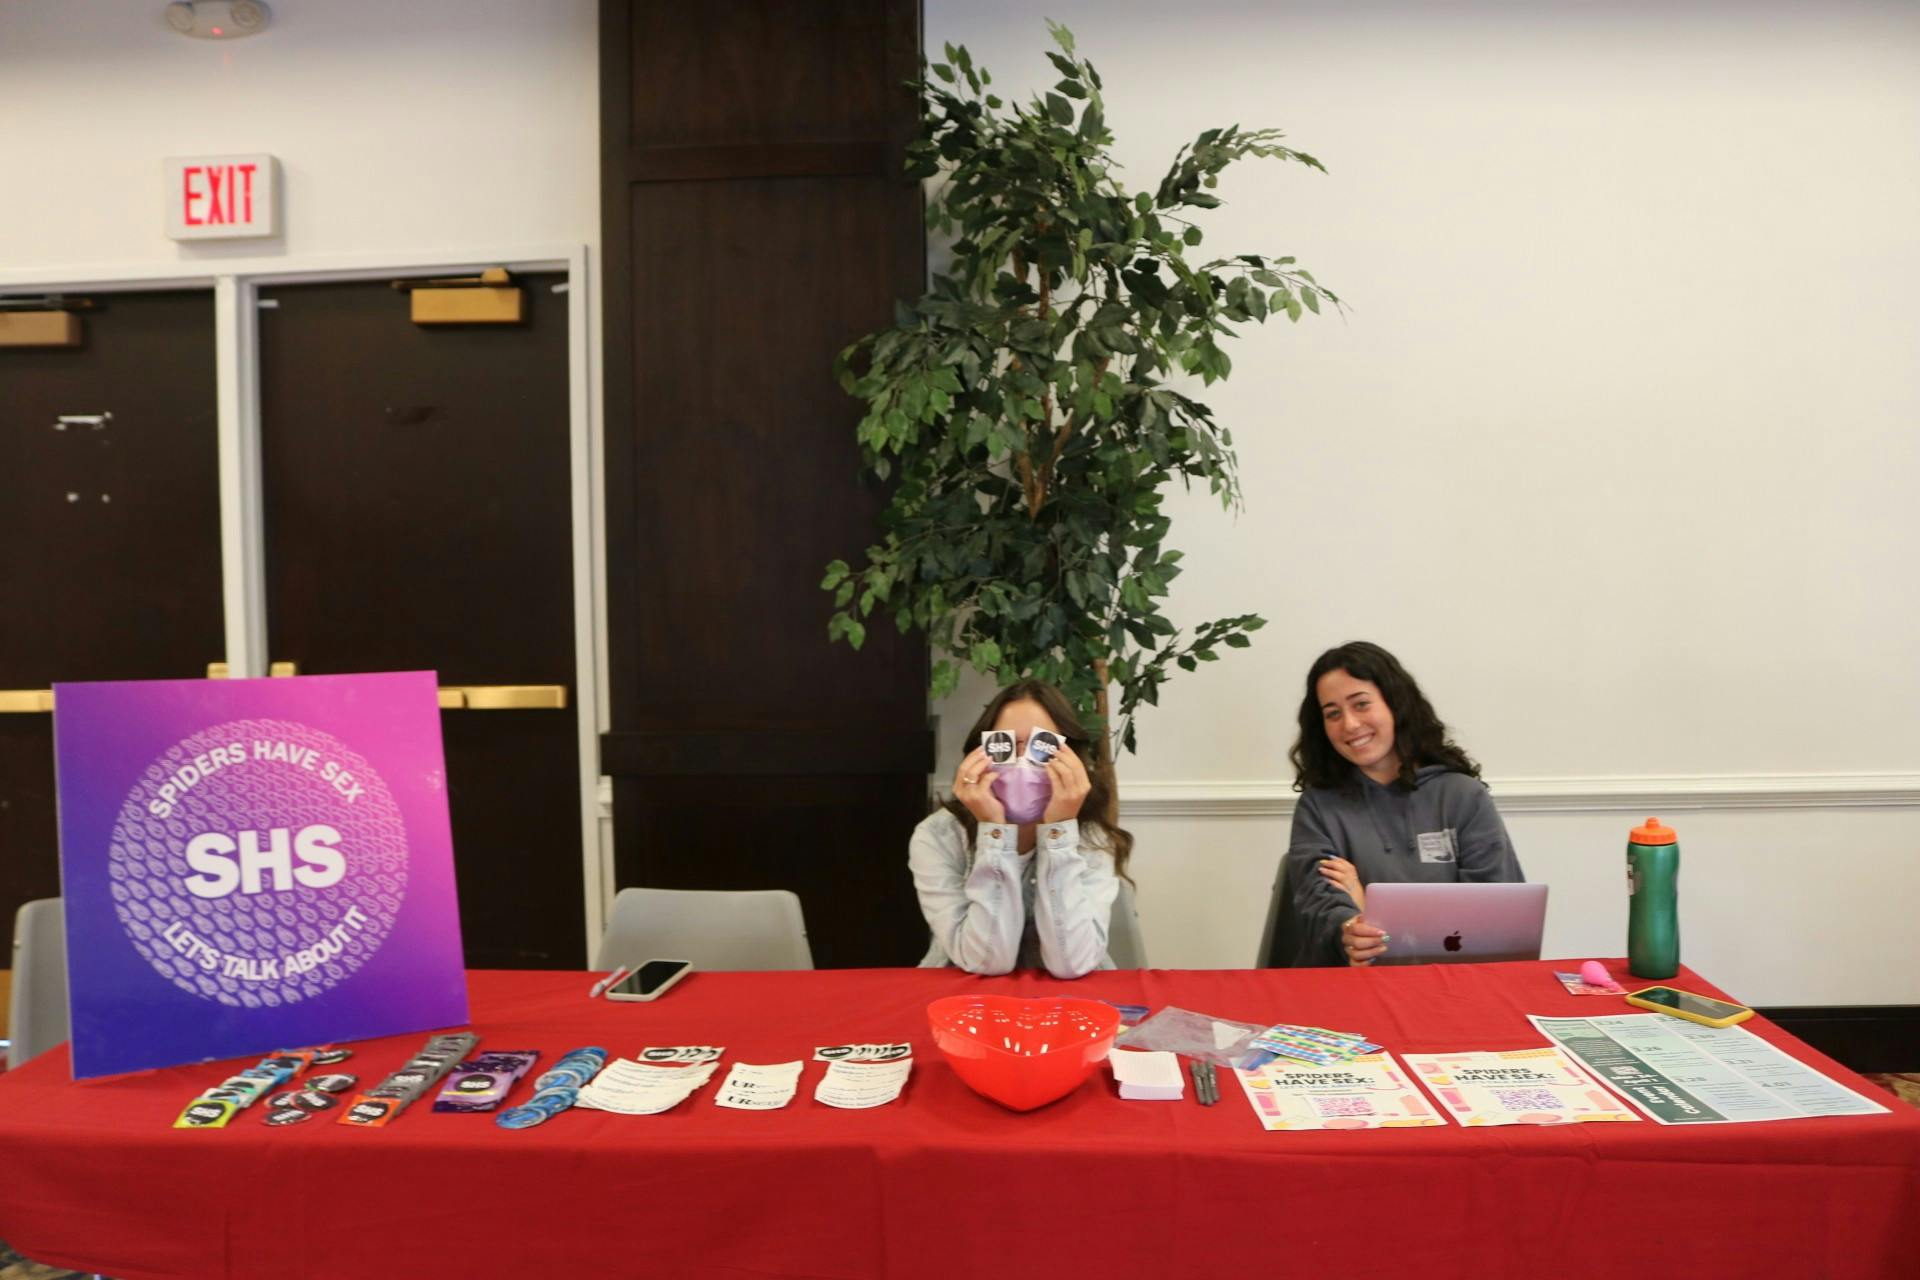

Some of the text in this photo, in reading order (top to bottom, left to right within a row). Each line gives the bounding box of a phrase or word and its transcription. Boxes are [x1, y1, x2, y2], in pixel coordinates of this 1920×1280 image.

[184, 164, 256, 225] EXIT
[148, 740, 365, 819] SPIDERS HAVE SEX
[988, 742, 1011, 753] SHS
[1033, 740, 1057, 755] SHS
[184, 824, 347, 899] SHS
[162, 904, 369, 981] LET'S TALK ABOUT IT
